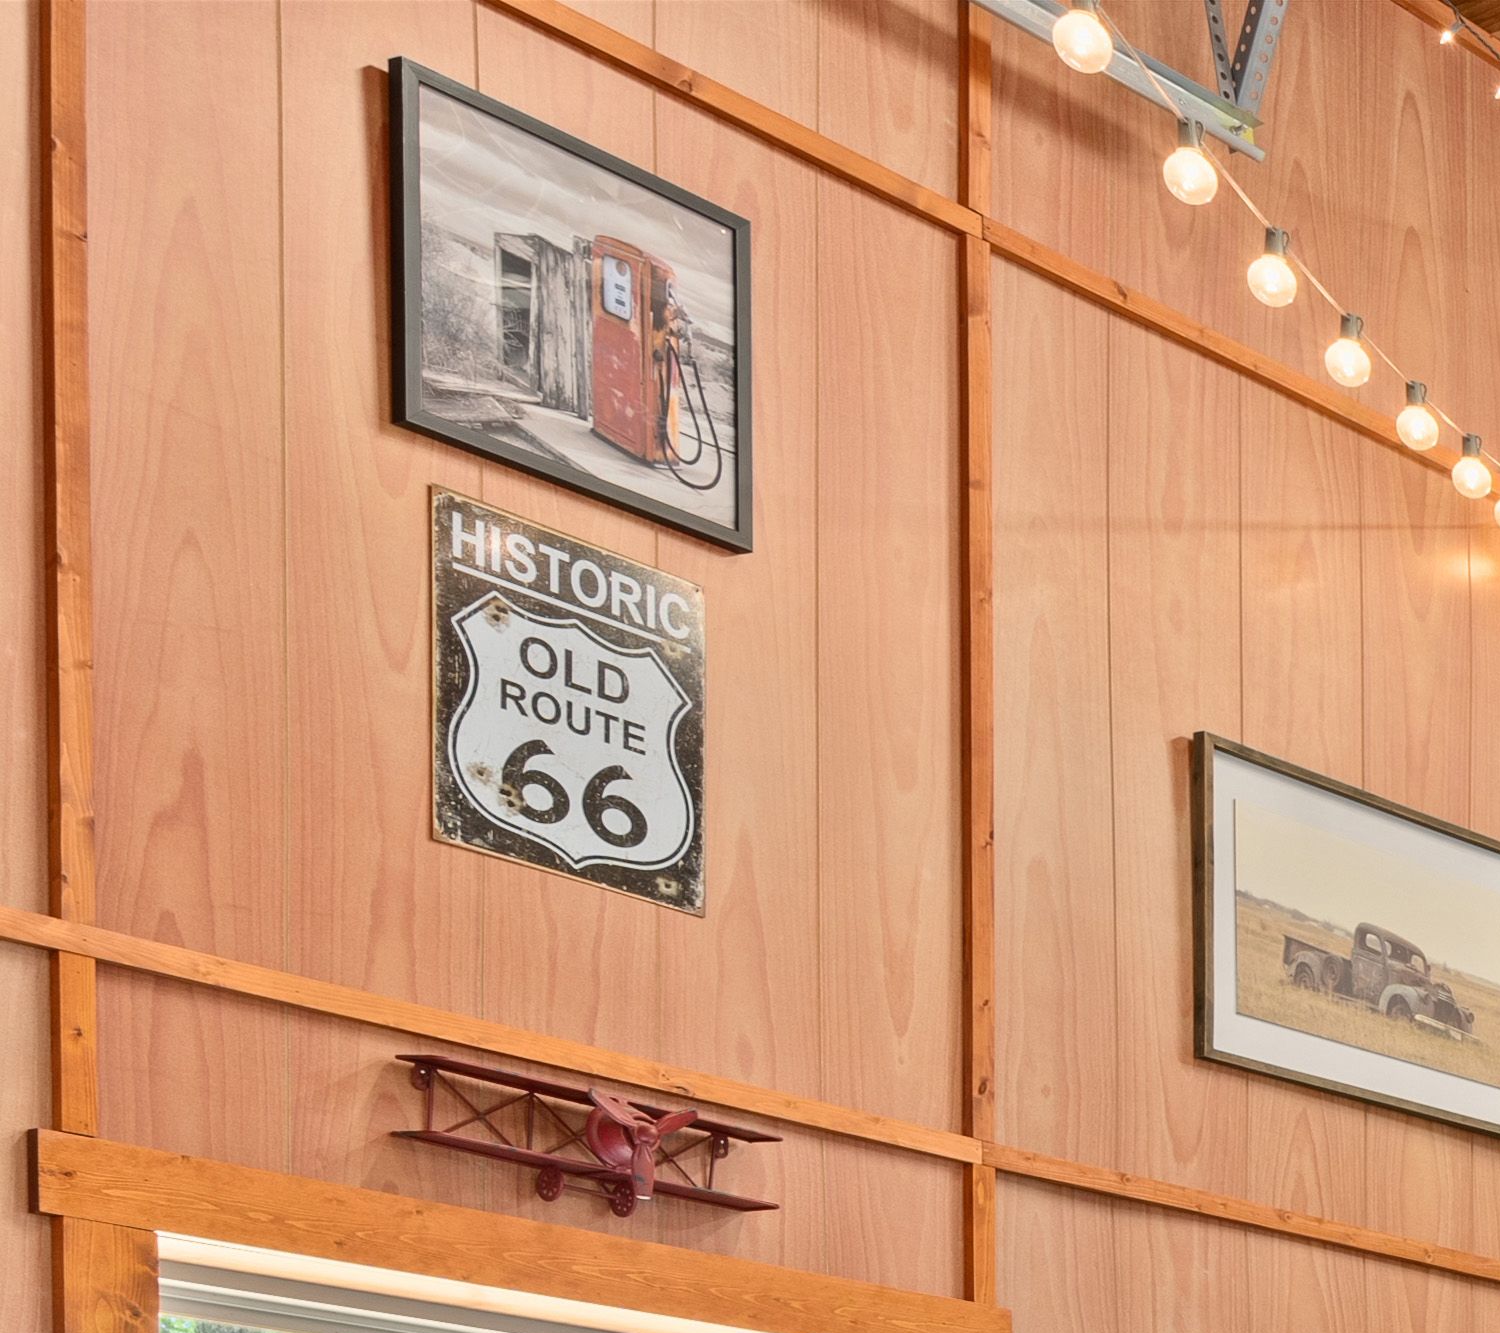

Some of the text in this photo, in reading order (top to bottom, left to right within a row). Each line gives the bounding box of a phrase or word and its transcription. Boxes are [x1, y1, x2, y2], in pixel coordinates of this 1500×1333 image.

[452, 511, 692, 641] HISTORIC
[500, 677, 647, 757] ROUTE
[519, 636, 630, 704] OLD
[502, 738, 648, 848] 66
